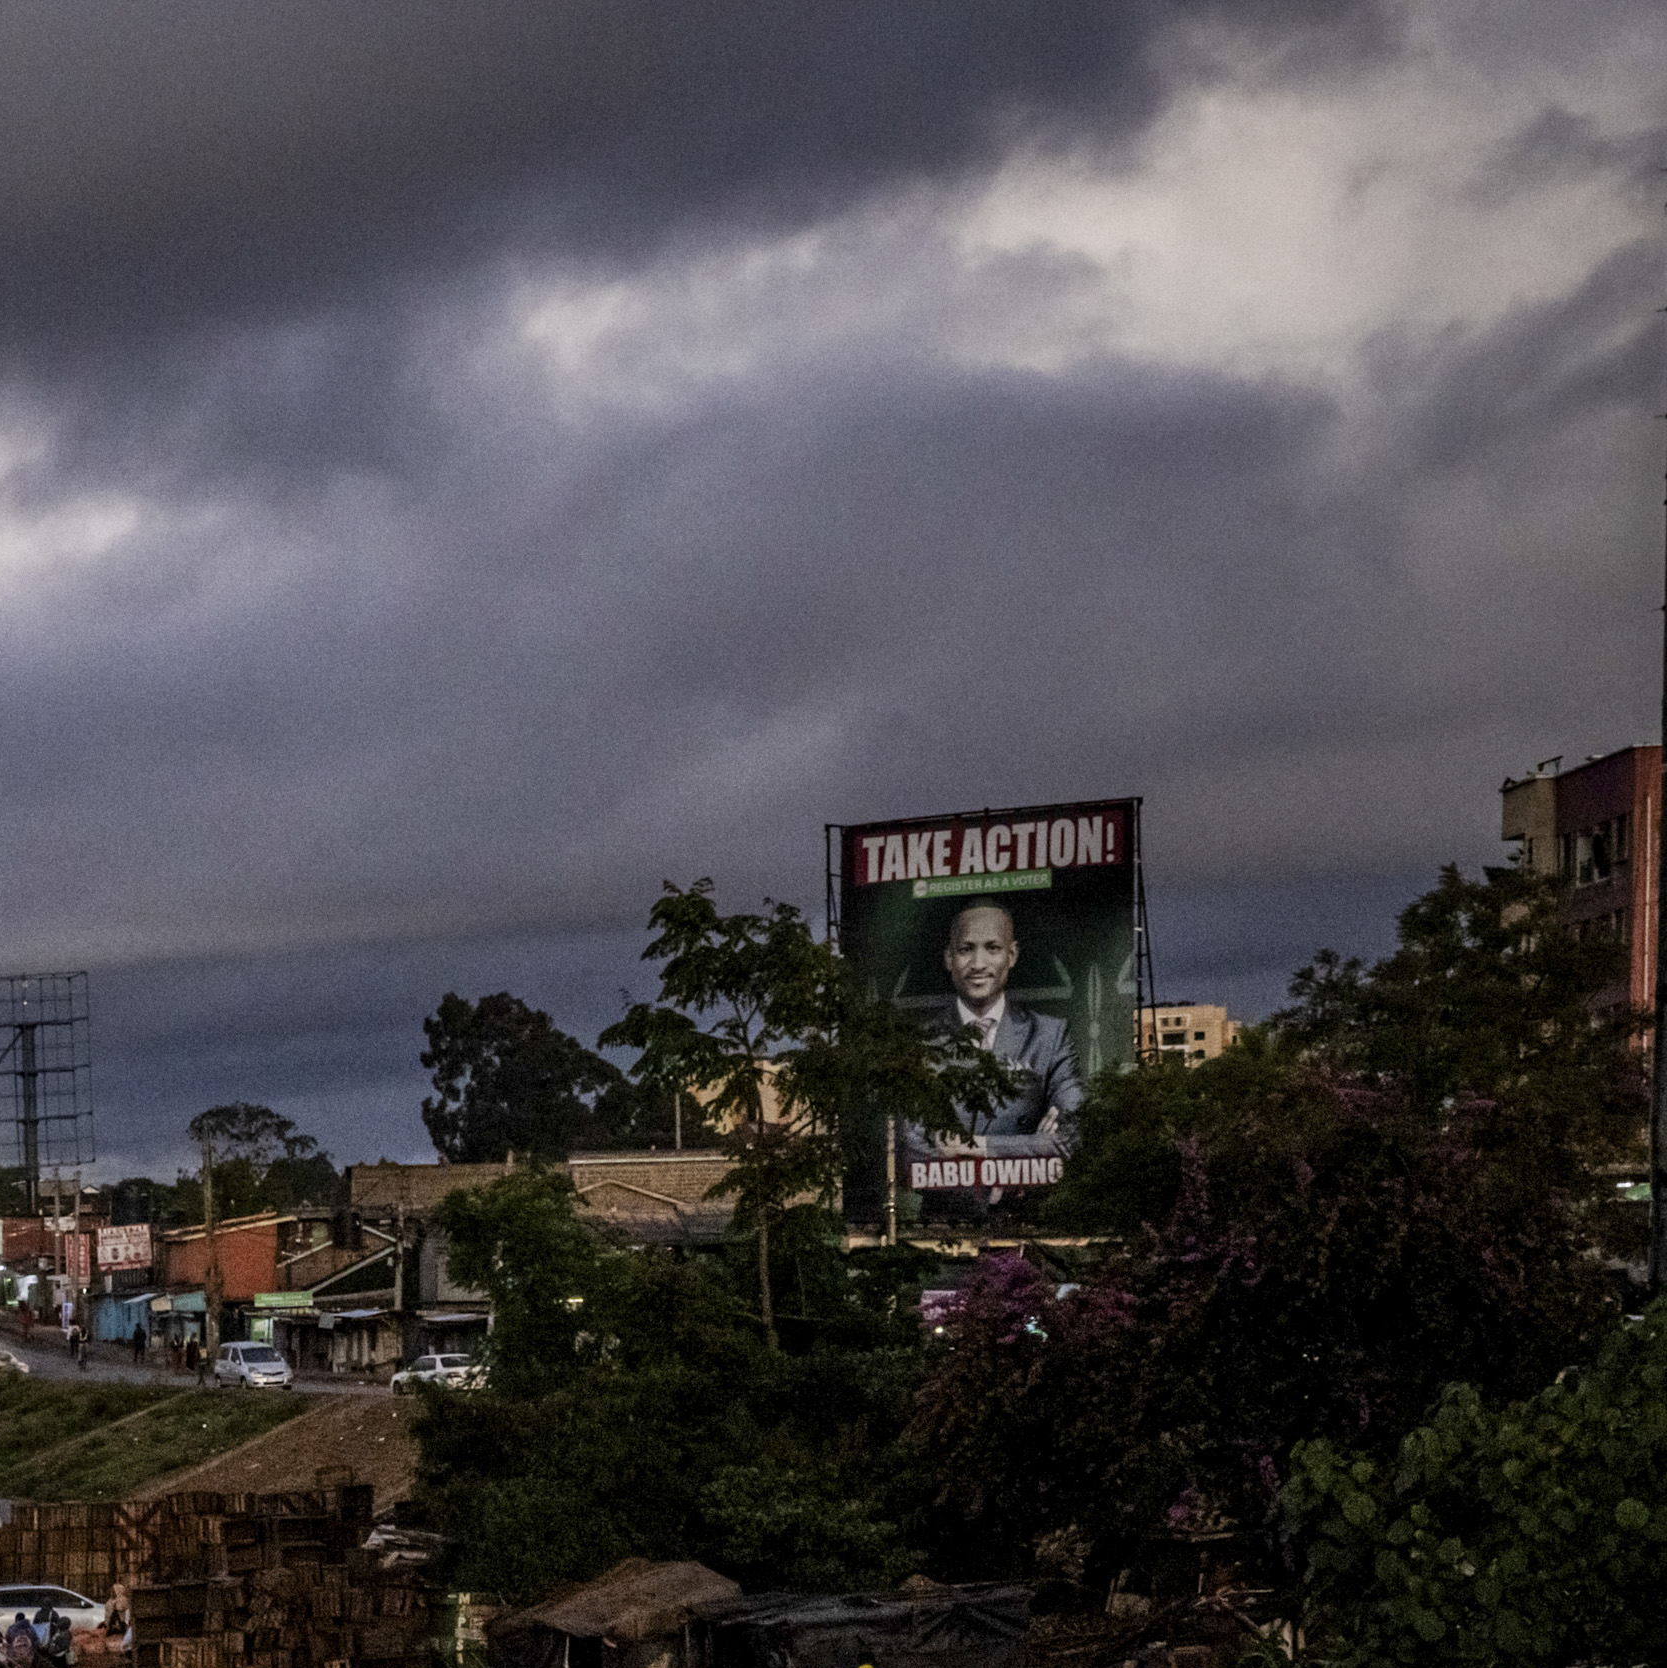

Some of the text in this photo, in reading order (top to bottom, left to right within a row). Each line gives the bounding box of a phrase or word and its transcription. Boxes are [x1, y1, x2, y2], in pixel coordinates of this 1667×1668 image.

[862, 816, 1114, 883] TAKE ACTION!
[929, 878, 982, 893] REGISTER
[984, 876, 999, 889] AS
[1002, 875, 1011, 886] A
[1012, 873, 1048, 886] VOTER
[911, 1161, 975, 1188] BABU
